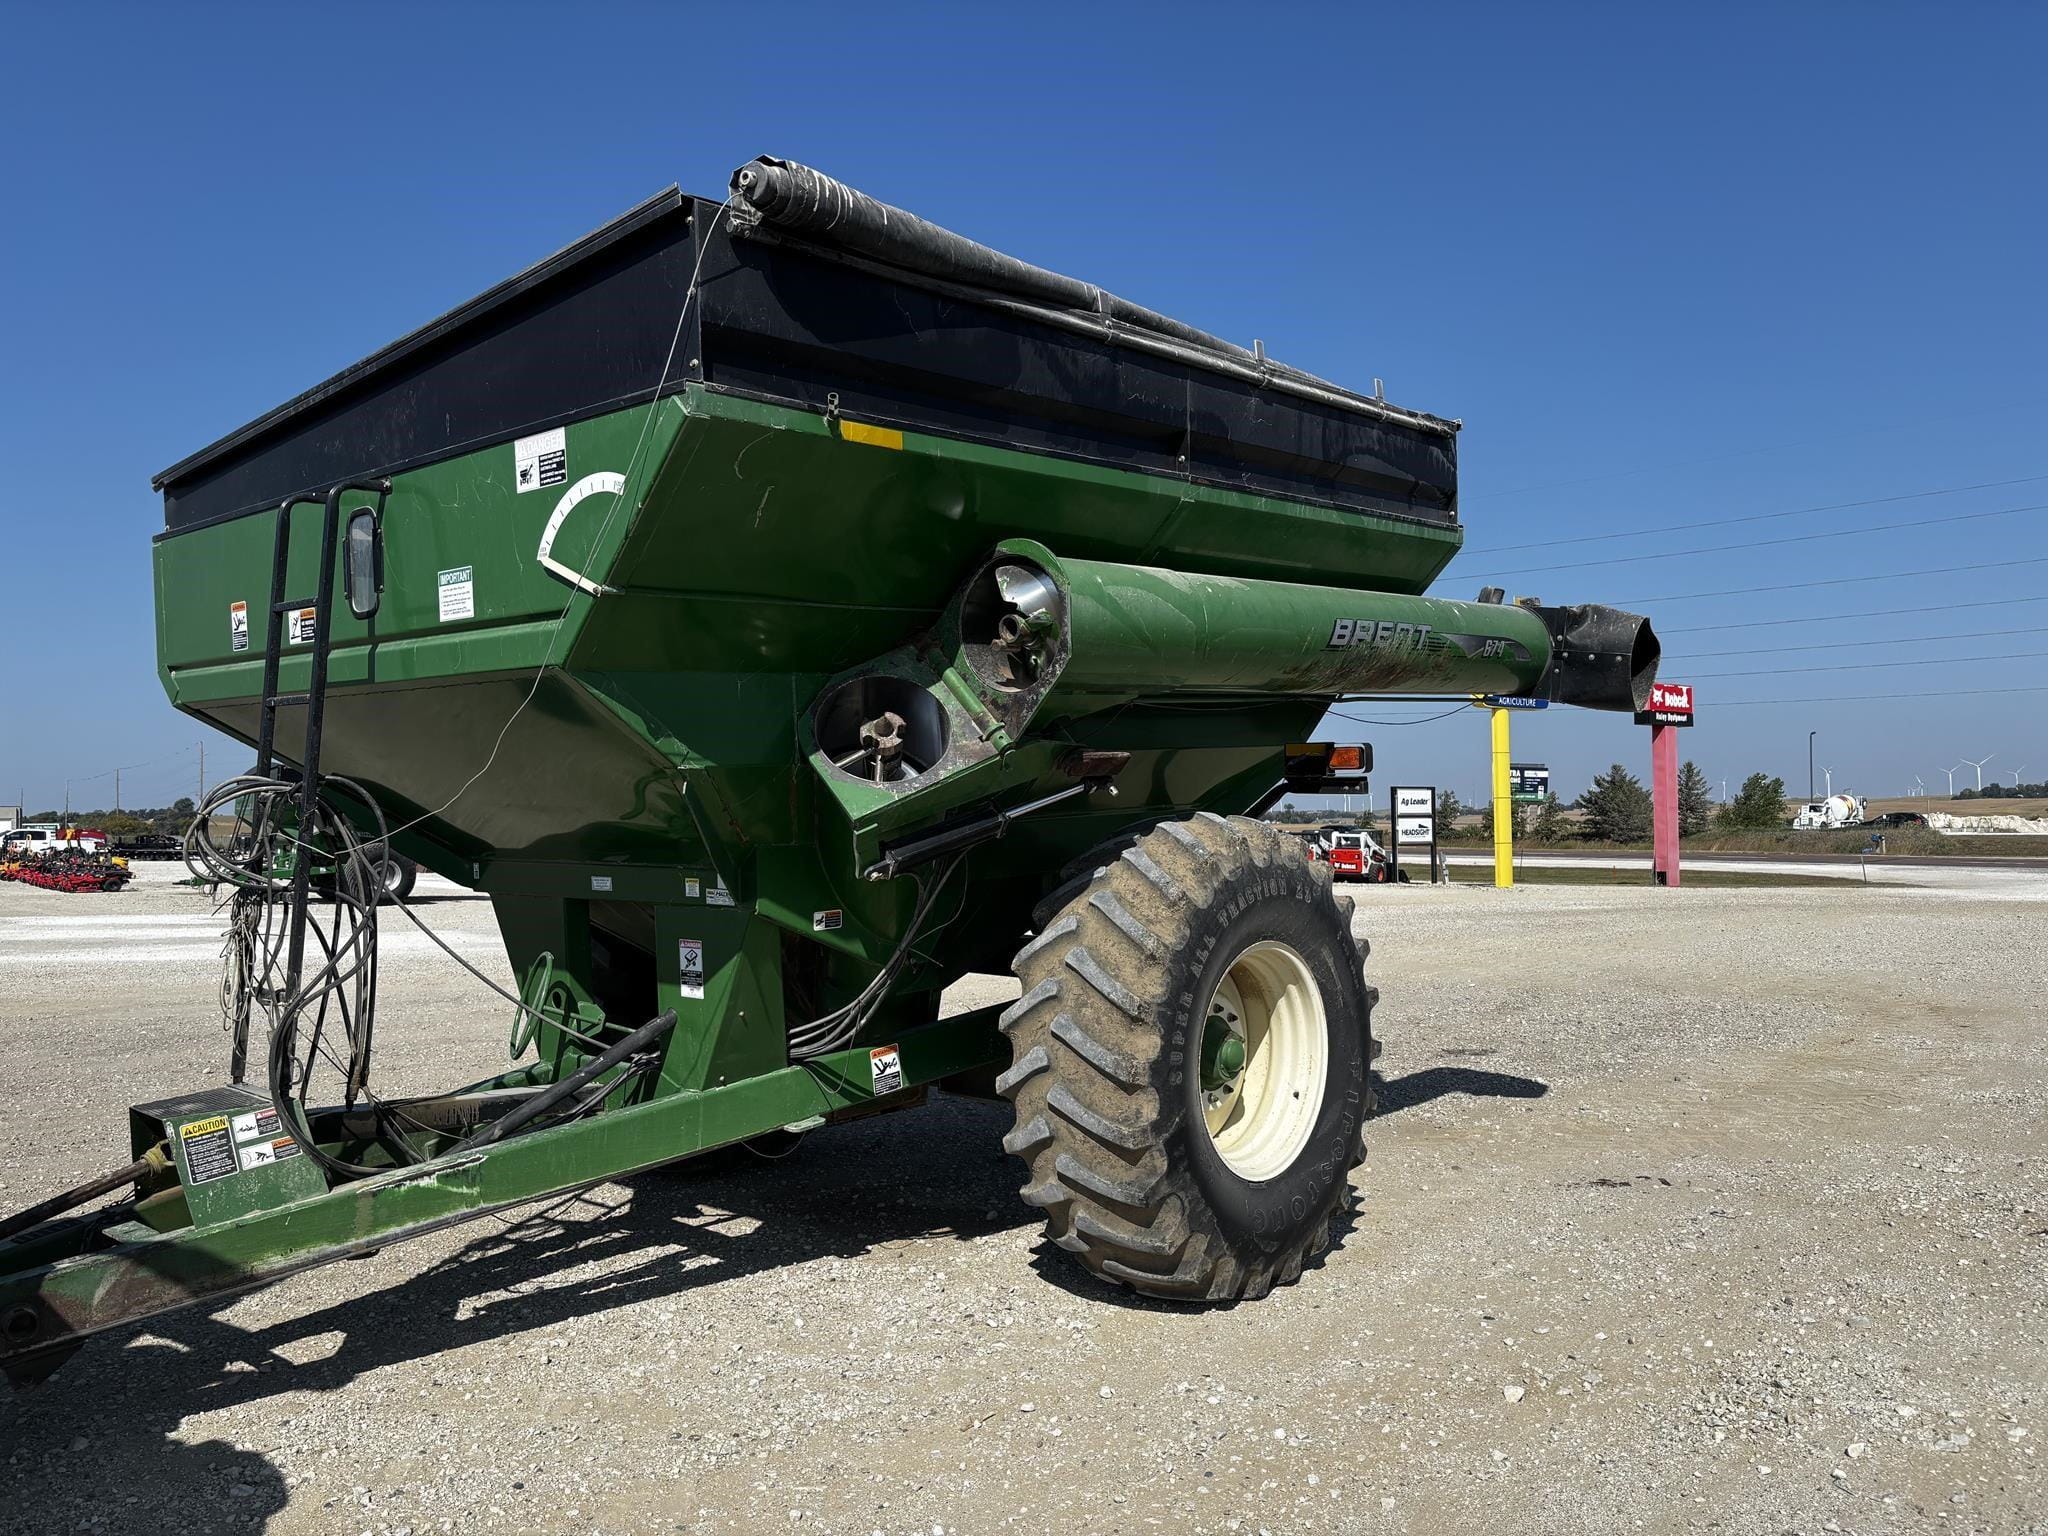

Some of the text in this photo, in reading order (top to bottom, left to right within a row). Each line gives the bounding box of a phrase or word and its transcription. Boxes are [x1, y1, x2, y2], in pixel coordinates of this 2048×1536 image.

[440, 570, 471, 586] IMPORTANT
[1328, 618, 1432, 651] BRENT
[1498, 697, 1537, 707] AGRICULTURE
[1664, 689, 1690, 708] Bobcat
[1400, 797, 1428, 806] Ag Leader
[1168, 991, 1195, 1086] SUPER
[1190, 933, 1217, 979] ALL
[1216, 878, 1288, 928] TRACTION
[192, 1118, 226, 1134] CAUTION
